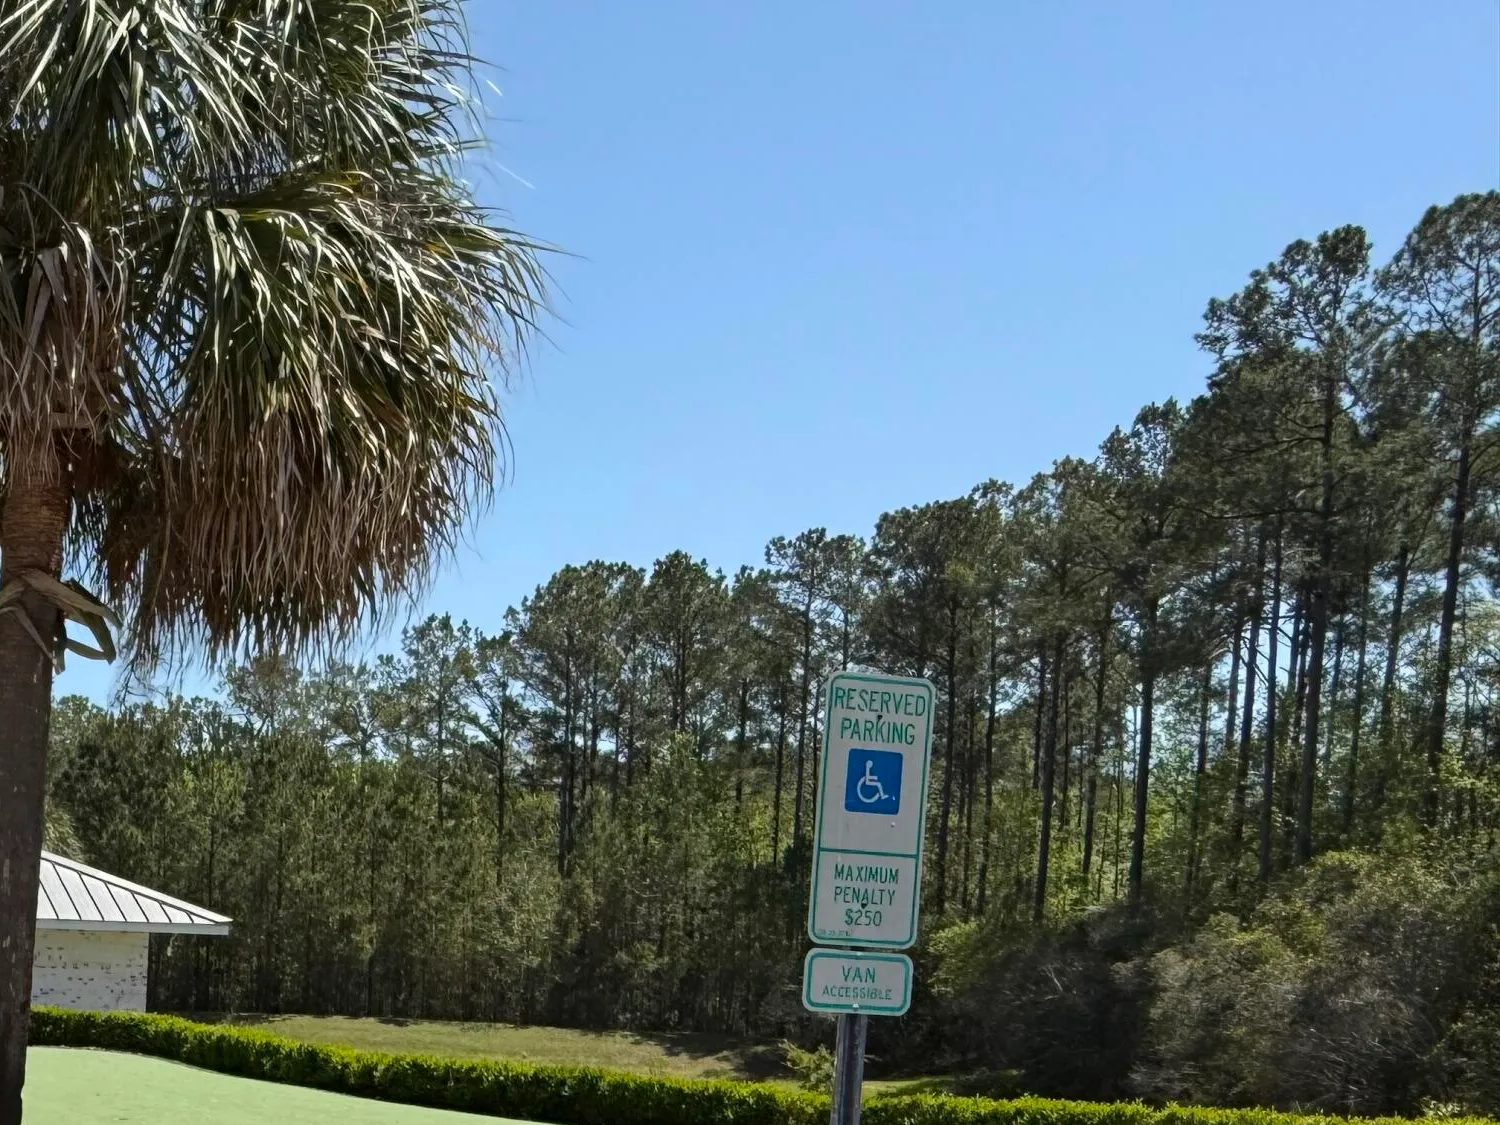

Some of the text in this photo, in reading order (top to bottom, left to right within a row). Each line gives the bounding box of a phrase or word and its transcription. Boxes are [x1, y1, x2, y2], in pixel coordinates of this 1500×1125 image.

[834, 686, 926, 717] RESERVED
[840, 717, 916, 745] PARKING
[834, 863, 900, 884] MAXIMUM
[834, 886, 896, 906] PENALTY
[844, 908, 883, 927] $250
[842, 965, 876, 983] VAN
[822, 985, 893, 1001] ACCESSIBLE
